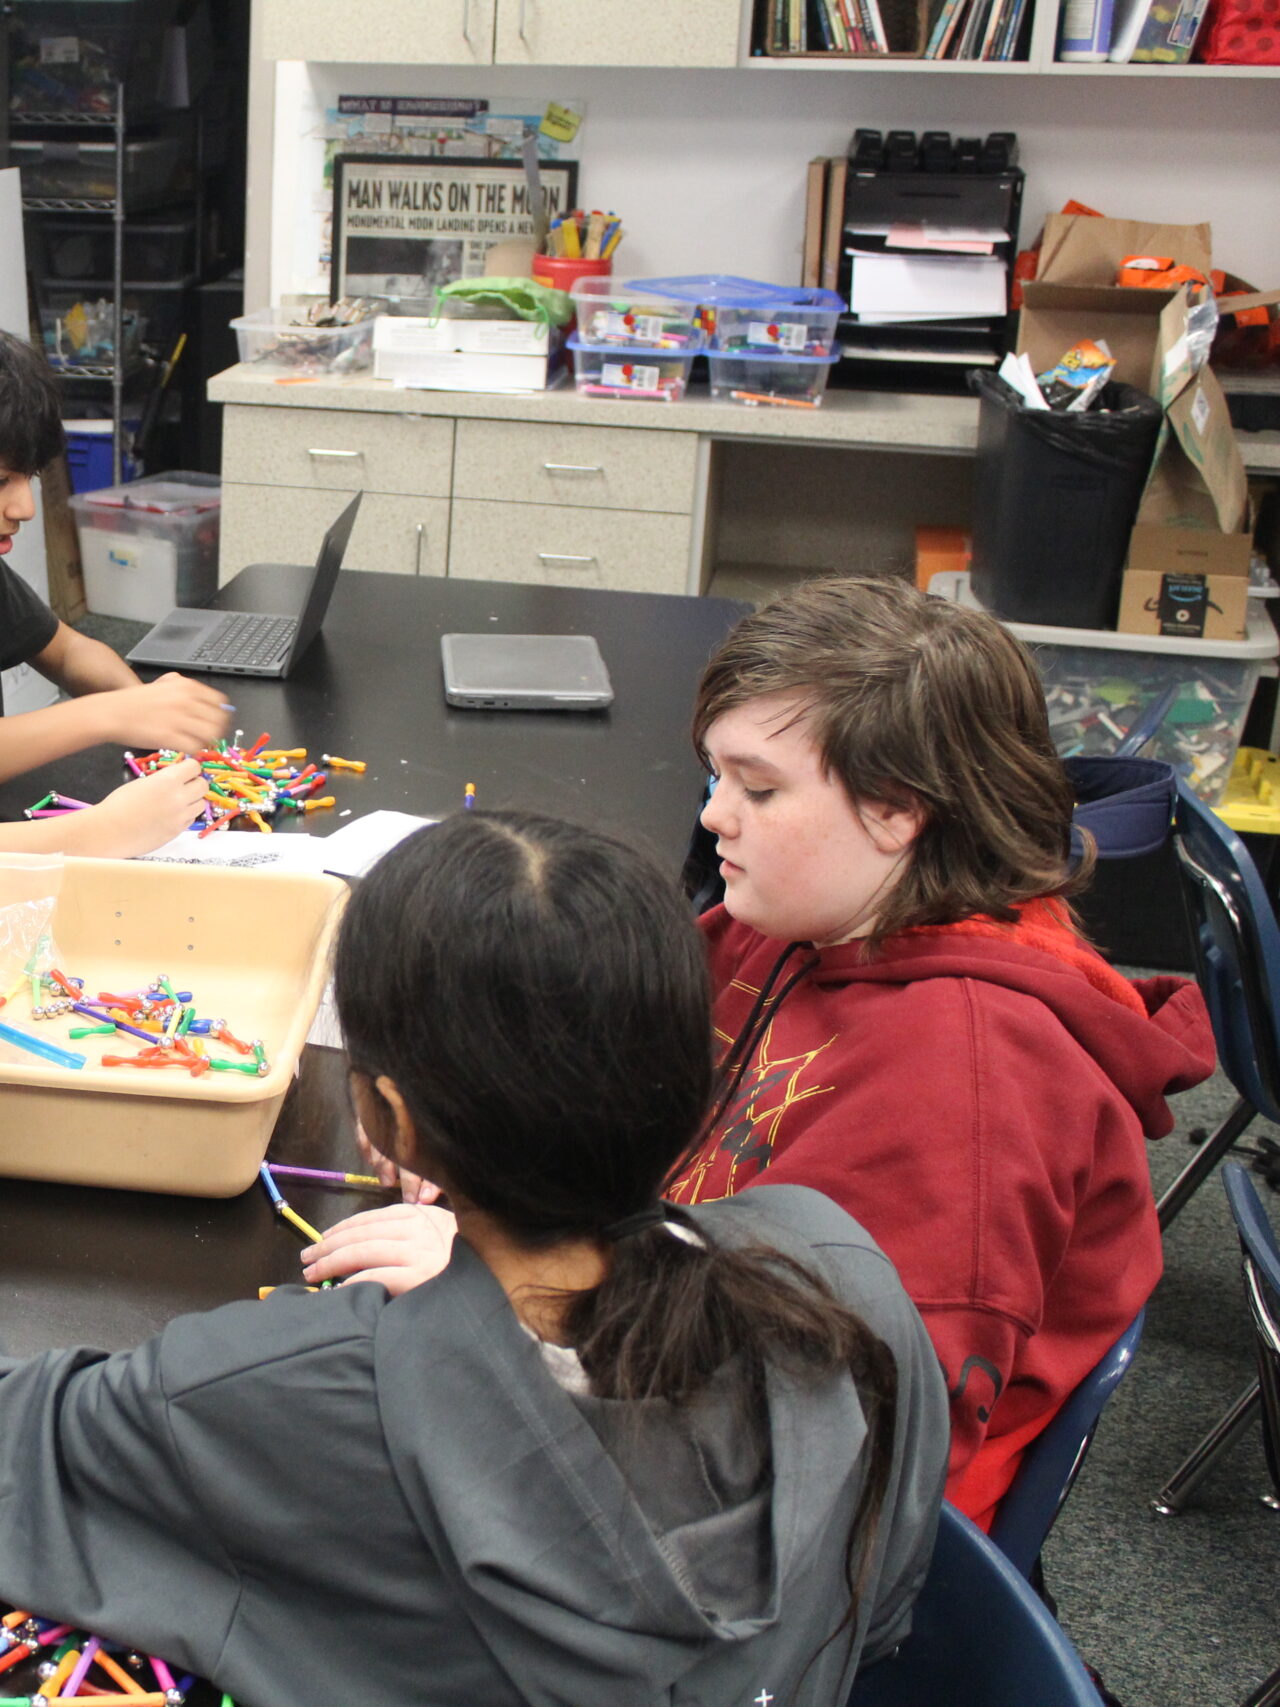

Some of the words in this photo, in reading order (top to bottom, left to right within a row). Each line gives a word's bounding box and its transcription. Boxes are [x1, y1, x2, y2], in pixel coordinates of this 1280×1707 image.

[347, 179, 383, 209] MAN
[388, 181, 444, 211] WALKS
[448, 182, 470, 213] ON
[476, 184, 506, 214] THE
[347, 214, 405, 231] MONUMENTAL
[408, 216, 434, 231] MOON
[436, 218, 476, 233] LANDING
[478, 219, 508, 234] OPENS
